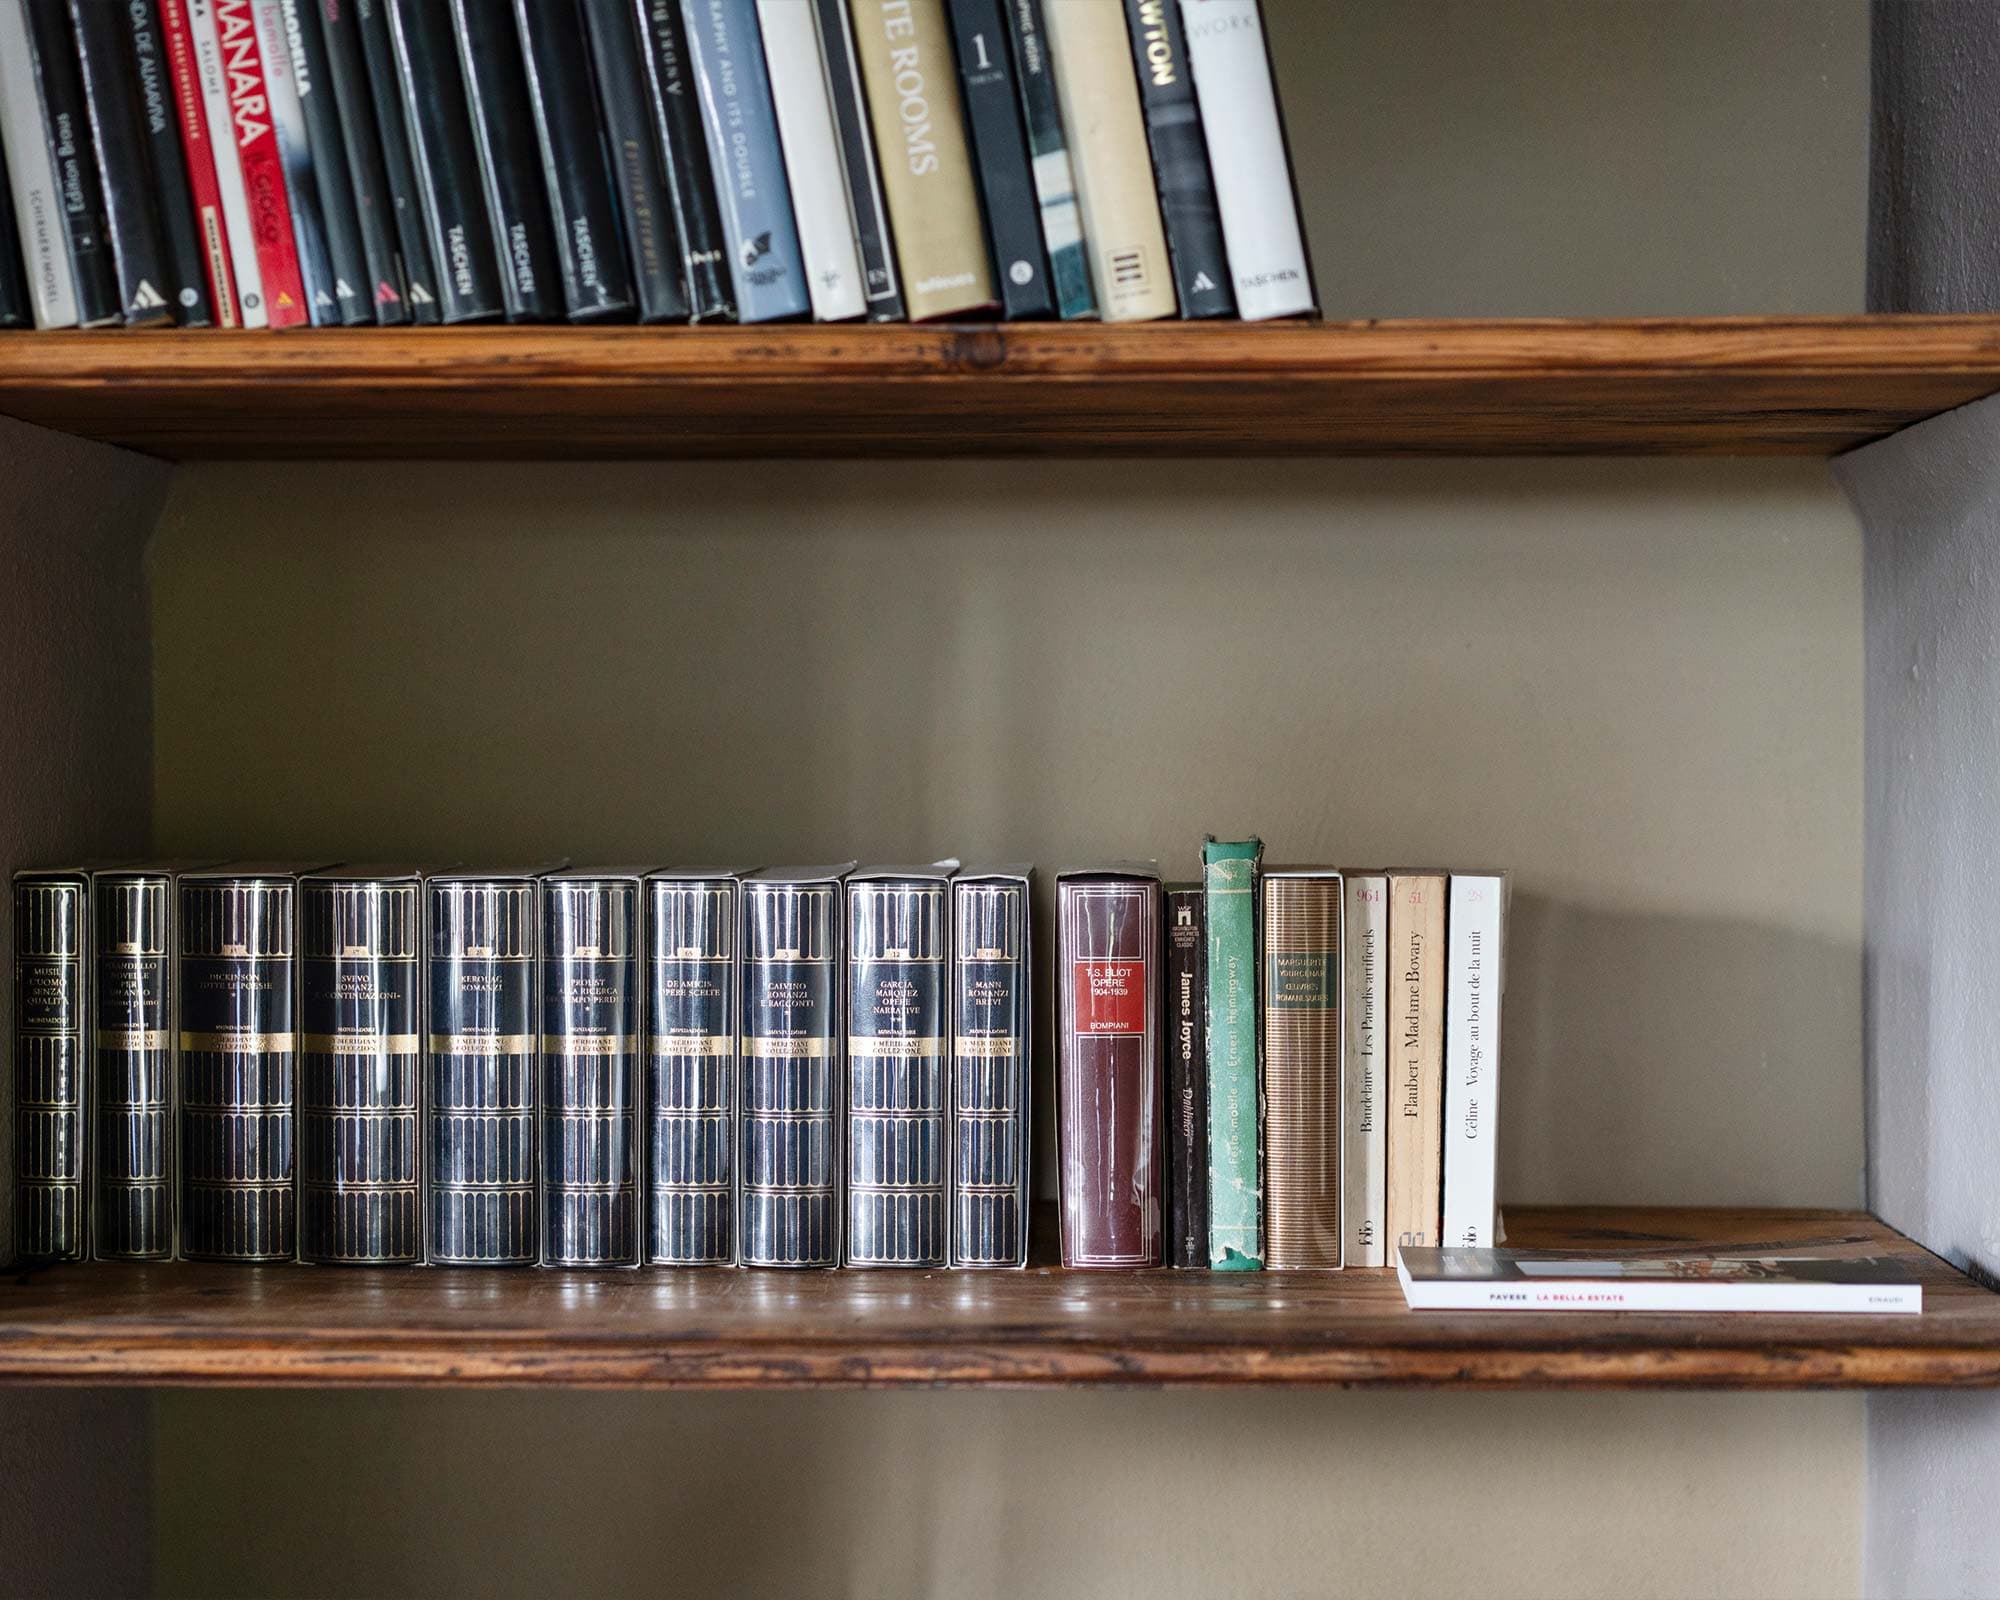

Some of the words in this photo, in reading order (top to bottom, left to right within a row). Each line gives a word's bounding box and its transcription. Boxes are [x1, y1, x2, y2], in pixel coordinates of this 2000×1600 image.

[972, 33, 992, 69] 1
[719, 59, 737, 98] AND
[731, 132, 756, 199] DOUBLE
[890, 46, 940, 178] ROOMS
[448, 224, 474, 296] TASCHEN
[510, 222, 535, 294] TASCHEN
[573, 215, 598, 288] TASCHEN
[1409, 892, 1422, 903] 51
[1361, 928, 1375, 984] artificiels
[1405, 930, 1424, 982] Bovary
[1468, 931, 1481, 956] nuit
[209, 974, 260, 982] DICKINSON
[1093, 978, 1125, 987] OPERE
[1105, 968, 1132, 977] ELIOT
[1467, 958, 1481, 971] la
[1467, 973, 1481, 988] de
[580, 987, 619, 995] RICERCA
[688, 989, 721, 997] SCELTE
[767, 982, 807, 990] CALVINO
[882, 998, 912, 1006] OPERE
[1181, 972, 1193, 1016] James
[1227, 955, 1240, 1025] Hemingway
[873, 1006, 921, 1014] NARRATIVE
[1361, 986, 1373, 1030] Paradis
[1405, 986, 1419, 1049] Madame
[1466, 992, 1480, 1022] bout
[1090, 1022, 1129, 1030] BOMPIANI
[1181, 1020, 1194, 1060] Joyce
[1469, 1027, 1480, 1041] au
[1227, 1030, 1239, 1067] Ernest
[1361, 1036, 1373, 1056] Les
[1465, 1044, 1483, 1087] Voyage
[1360, 1067, 1373, 1133] Baudelaire
[1404, 1059, 1419, 1118] Flaubert
[1229, 1087, 1239, 1127] mobile
[1465, 1098, 1479, 1140] Céline
[1358, 1220, 1374, 1246] folio
[1463, 1226, 1478, 1248] olio
